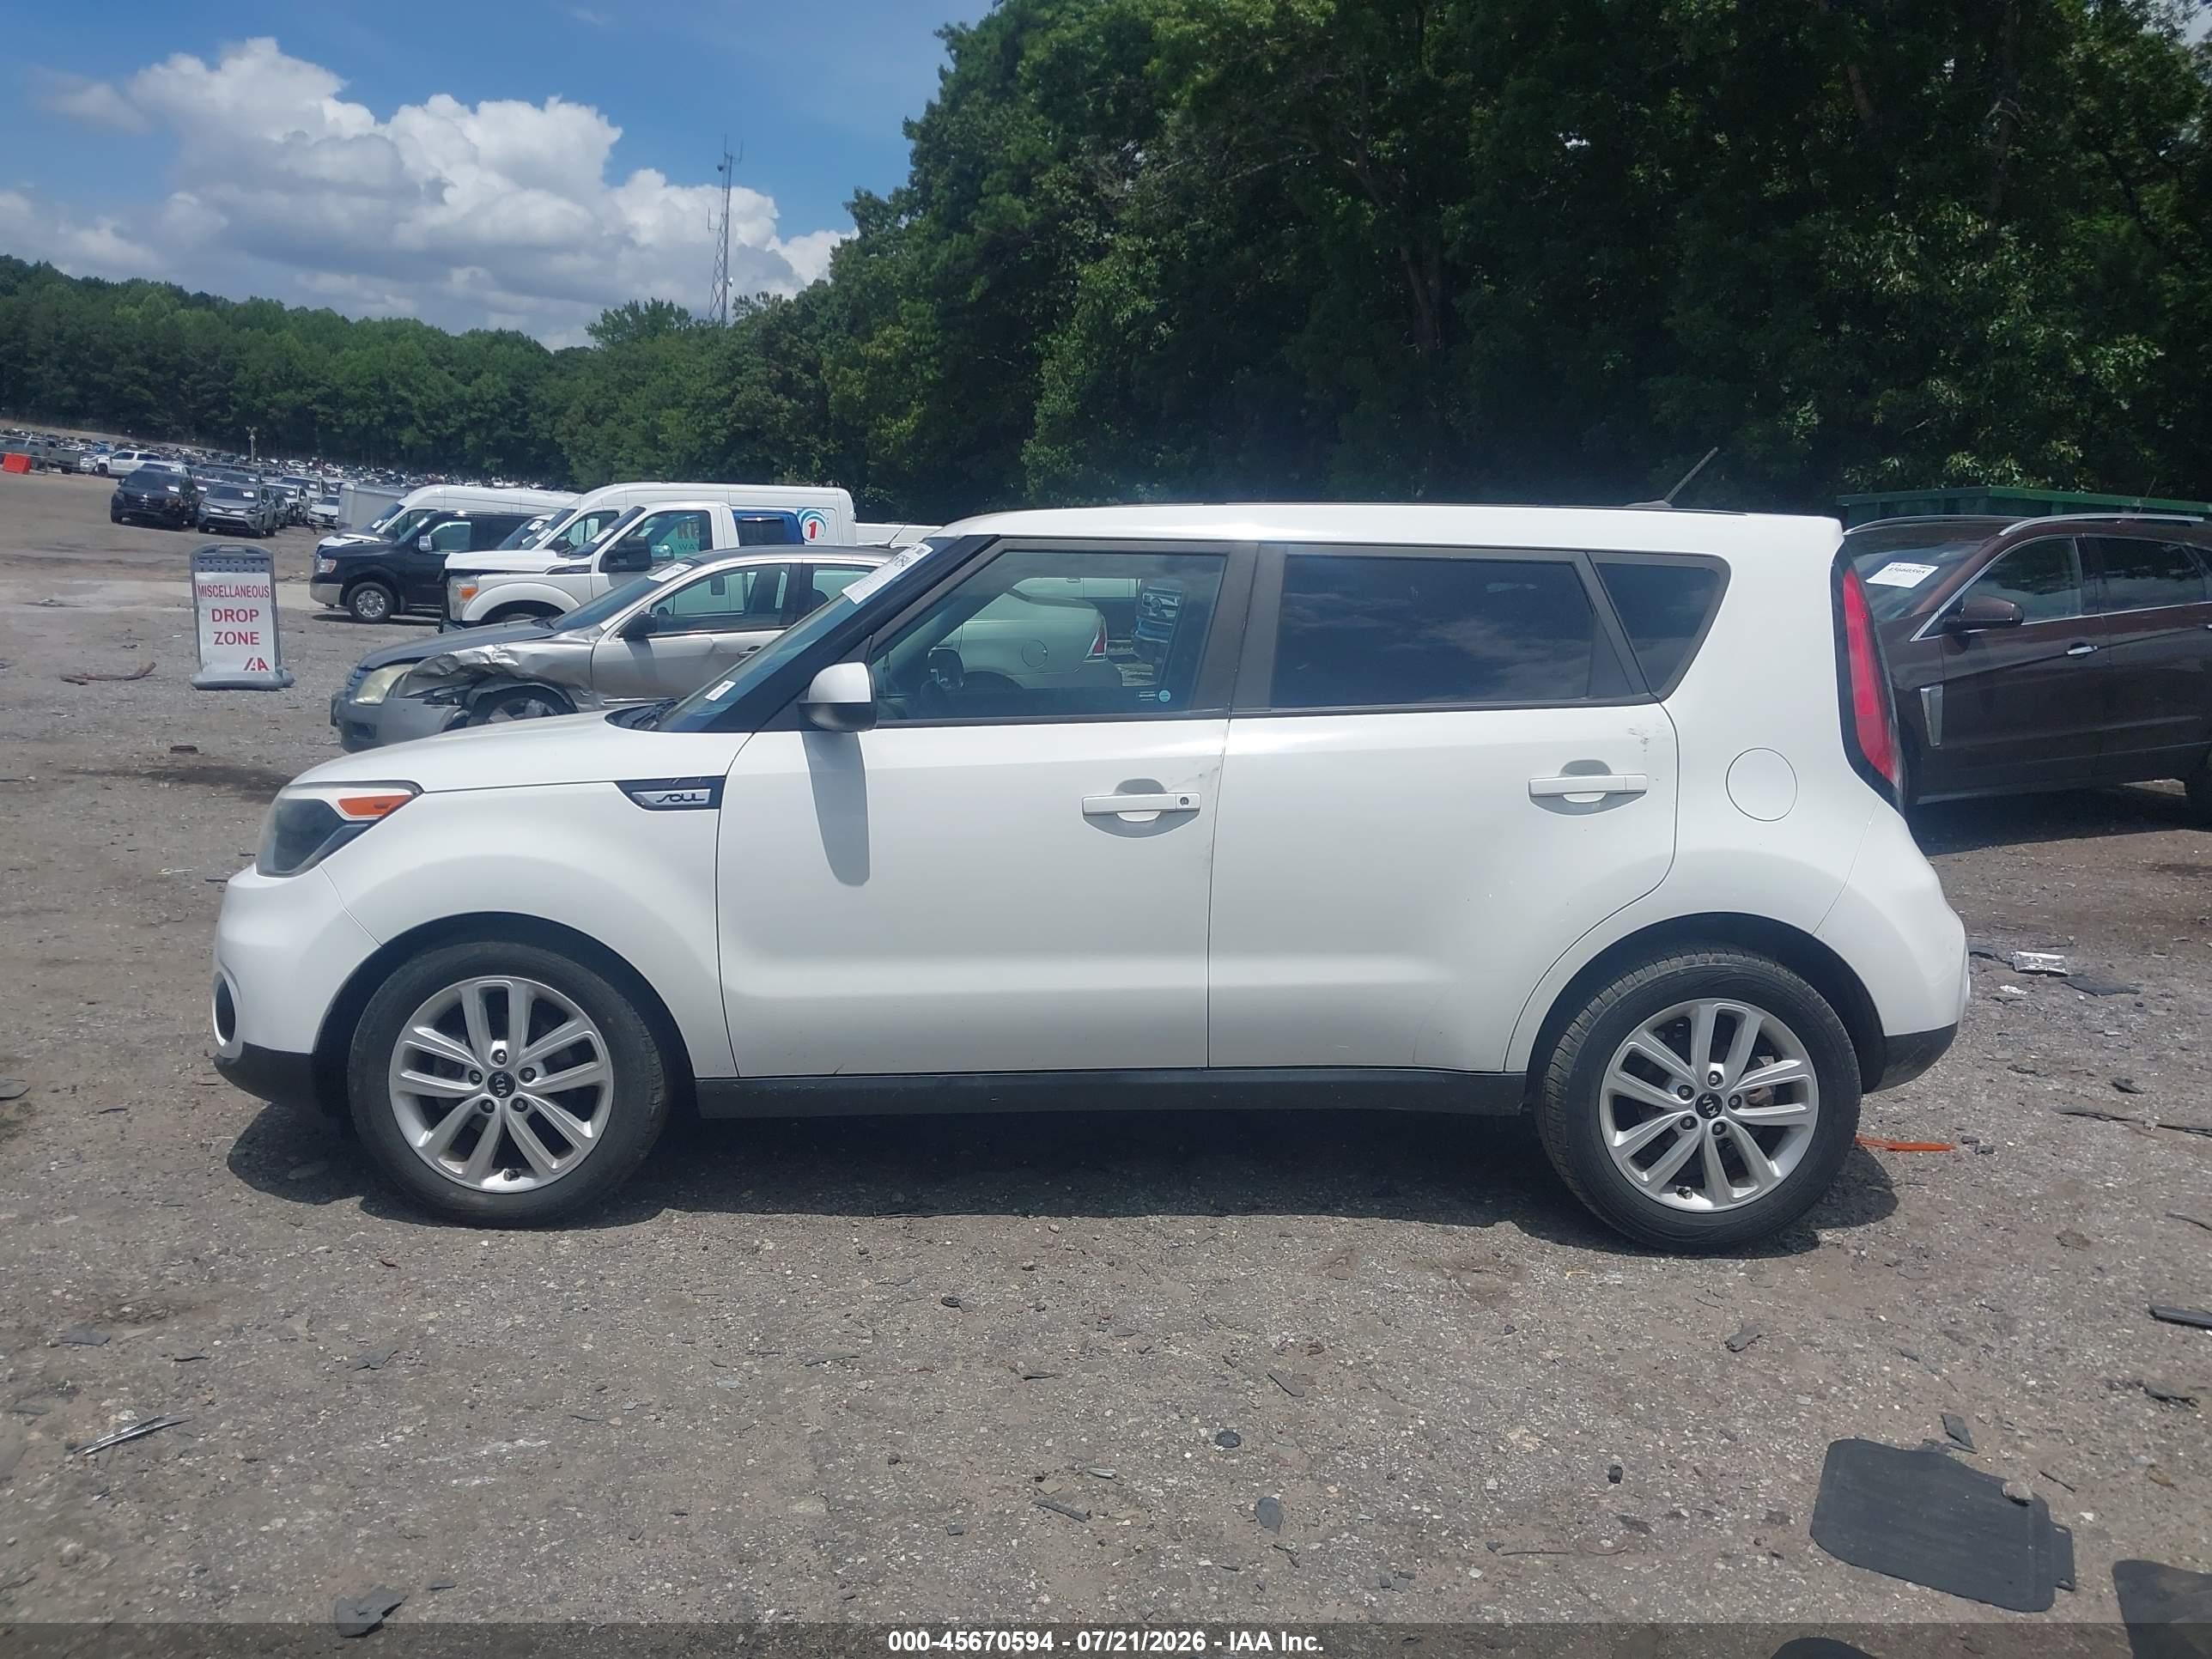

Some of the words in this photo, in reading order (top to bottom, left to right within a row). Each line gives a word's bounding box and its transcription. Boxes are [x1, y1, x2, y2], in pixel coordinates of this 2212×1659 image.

[198, 585, 270, 599] MISCELLANEOUS
[211, 608, 259, 623] DROP
[213, 631, 260, 646] ZONE
[656, 793, 706, 803] SOUL
[495, 1073, 507, 1097] KIA
[1702, 1095, 1718, 1117] KIA
